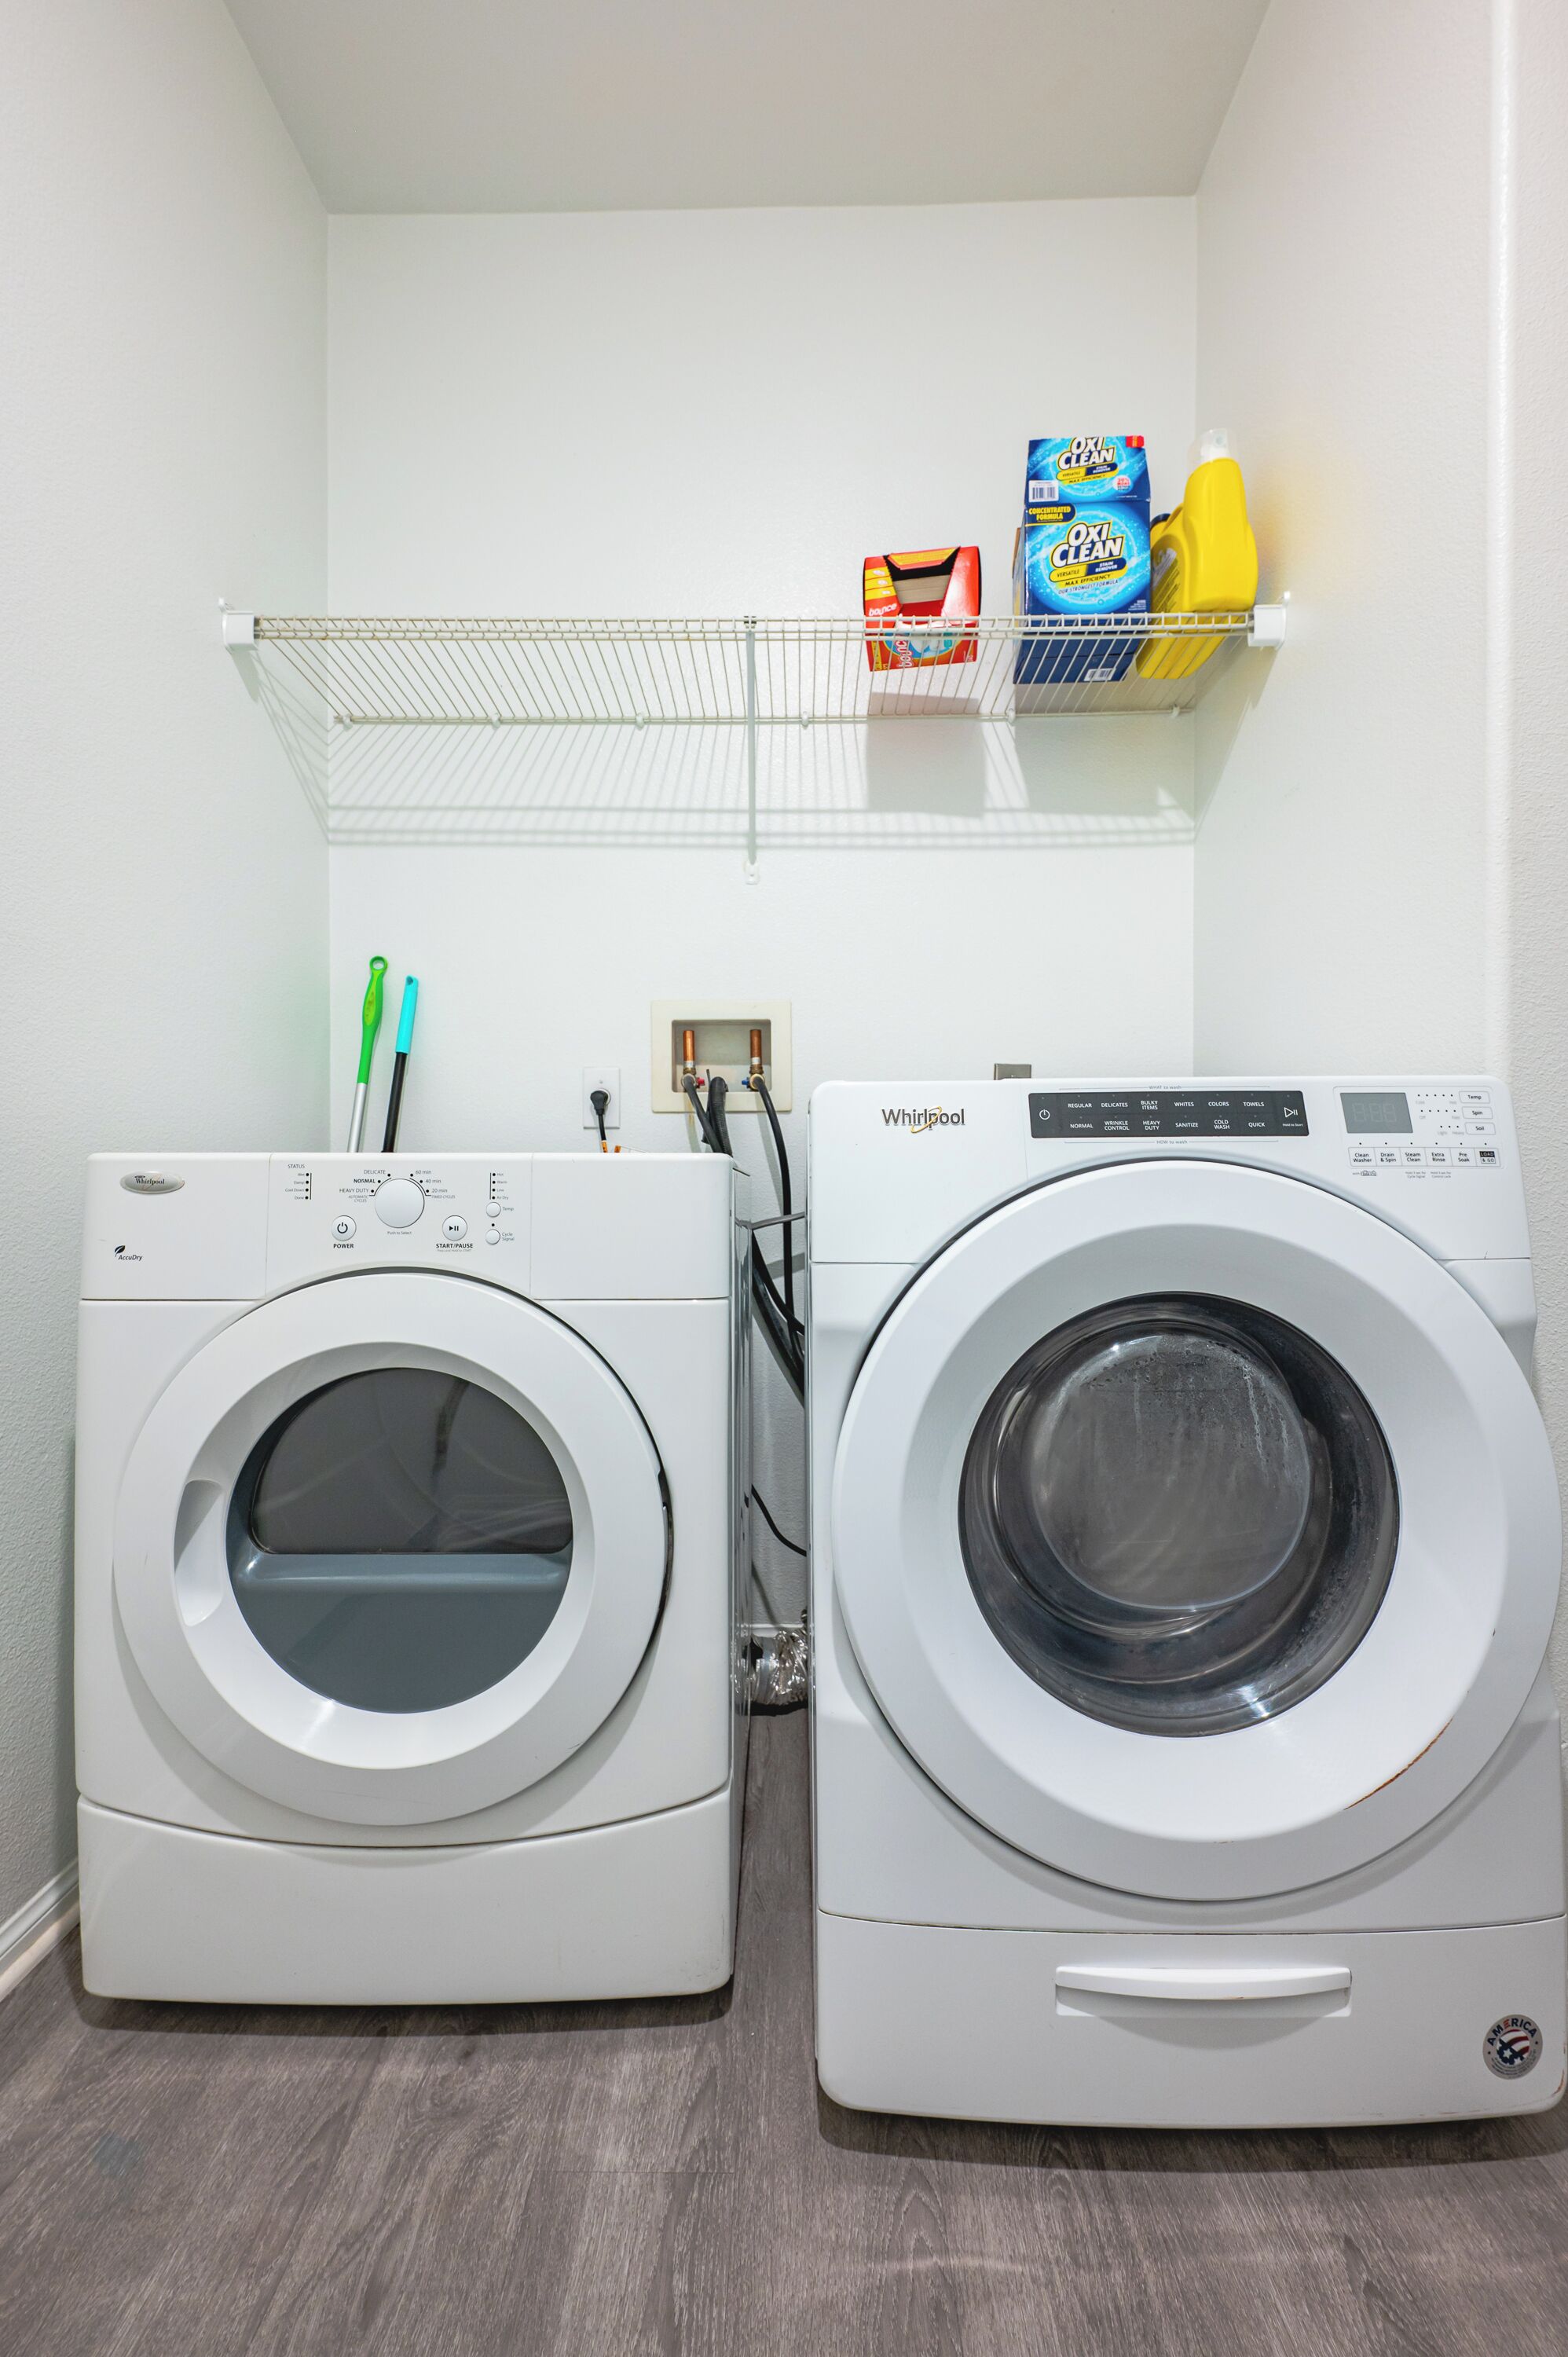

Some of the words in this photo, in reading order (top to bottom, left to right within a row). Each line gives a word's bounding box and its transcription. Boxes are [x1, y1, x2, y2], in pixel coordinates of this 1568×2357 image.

[1071, 437, 1105, 454] OXI
[1058, 448, 1115, 470] CLEAN
[1029, 506, 1071, 515] CONCENTRATED
[1068, 522, 1110, 546] OXI
[1052, 537, 1124, 567] CLEAN
[1057, 569, 1079, 577] VERSATILE
[1080, 574, 1111, 584] EFFICIENCY
[1069, 584, 1095, 593] STRONGEST
[869, 603, 897, 617] bounce
[881, 1109, 965, 1129] Whirlpool
[1487, 2018, 1537, 2047] AMERICA
